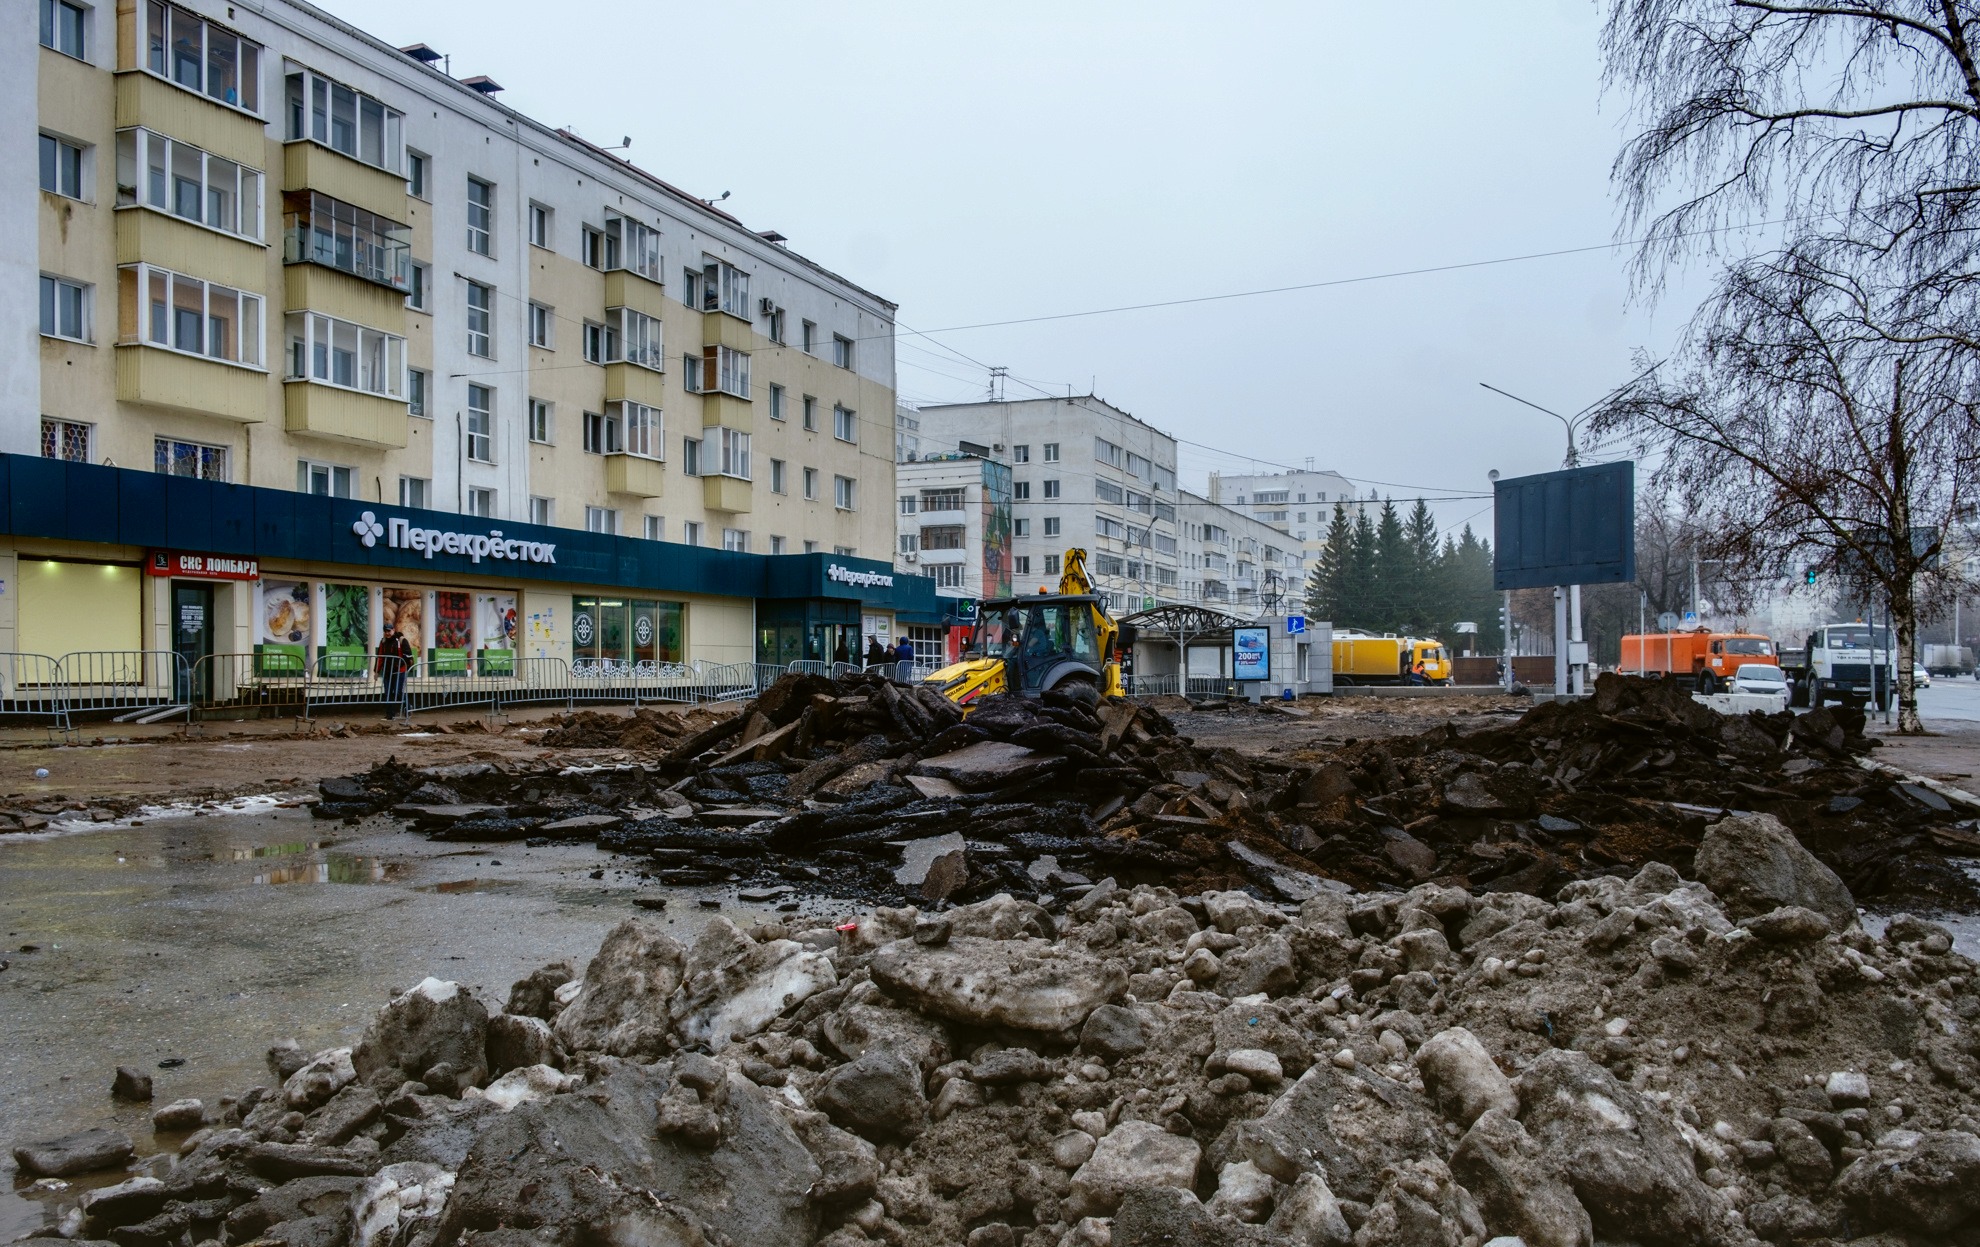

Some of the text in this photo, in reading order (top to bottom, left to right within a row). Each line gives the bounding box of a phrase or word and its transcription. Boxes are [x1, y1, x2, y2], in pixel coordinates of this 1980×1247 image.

[388, 517, 557, 564] Перекрёсток
[180, 555, 203, 571] СКС
[206, 557, 258, 576] ЛОМБАРД
[838, 566, 893, 588] Перекрёсток
